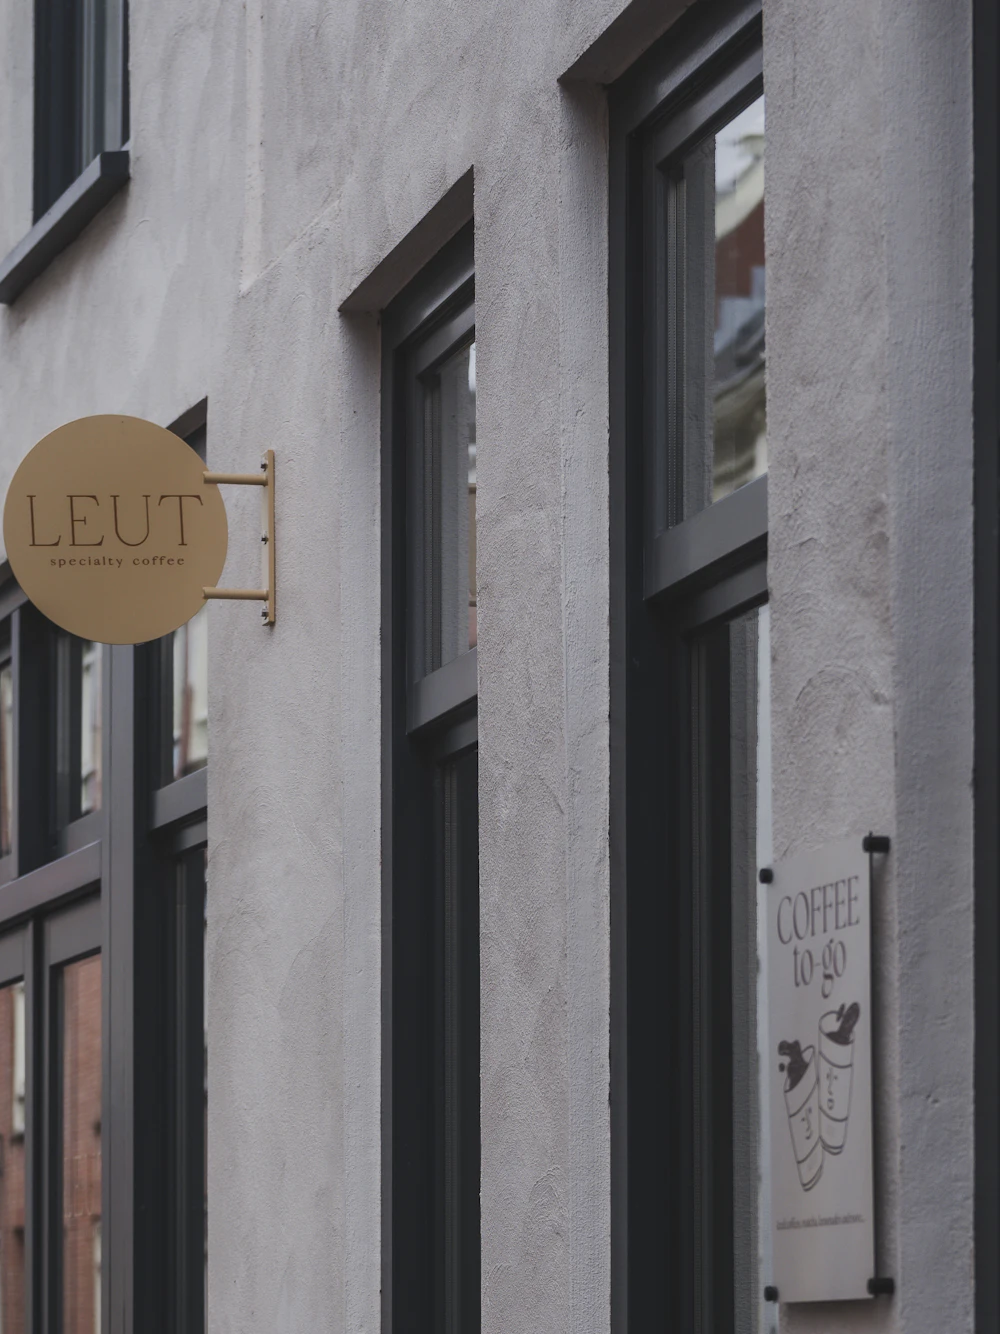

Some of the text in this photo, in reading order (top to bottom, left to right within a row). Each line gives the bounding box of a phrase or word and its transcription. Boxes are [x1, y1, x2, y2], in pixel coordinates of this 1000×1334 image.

[26, 494, 204, 547] LEUT
[50, 556, 185, 568] specialty coffee
[776, 874, 860, 945] COFFEE
